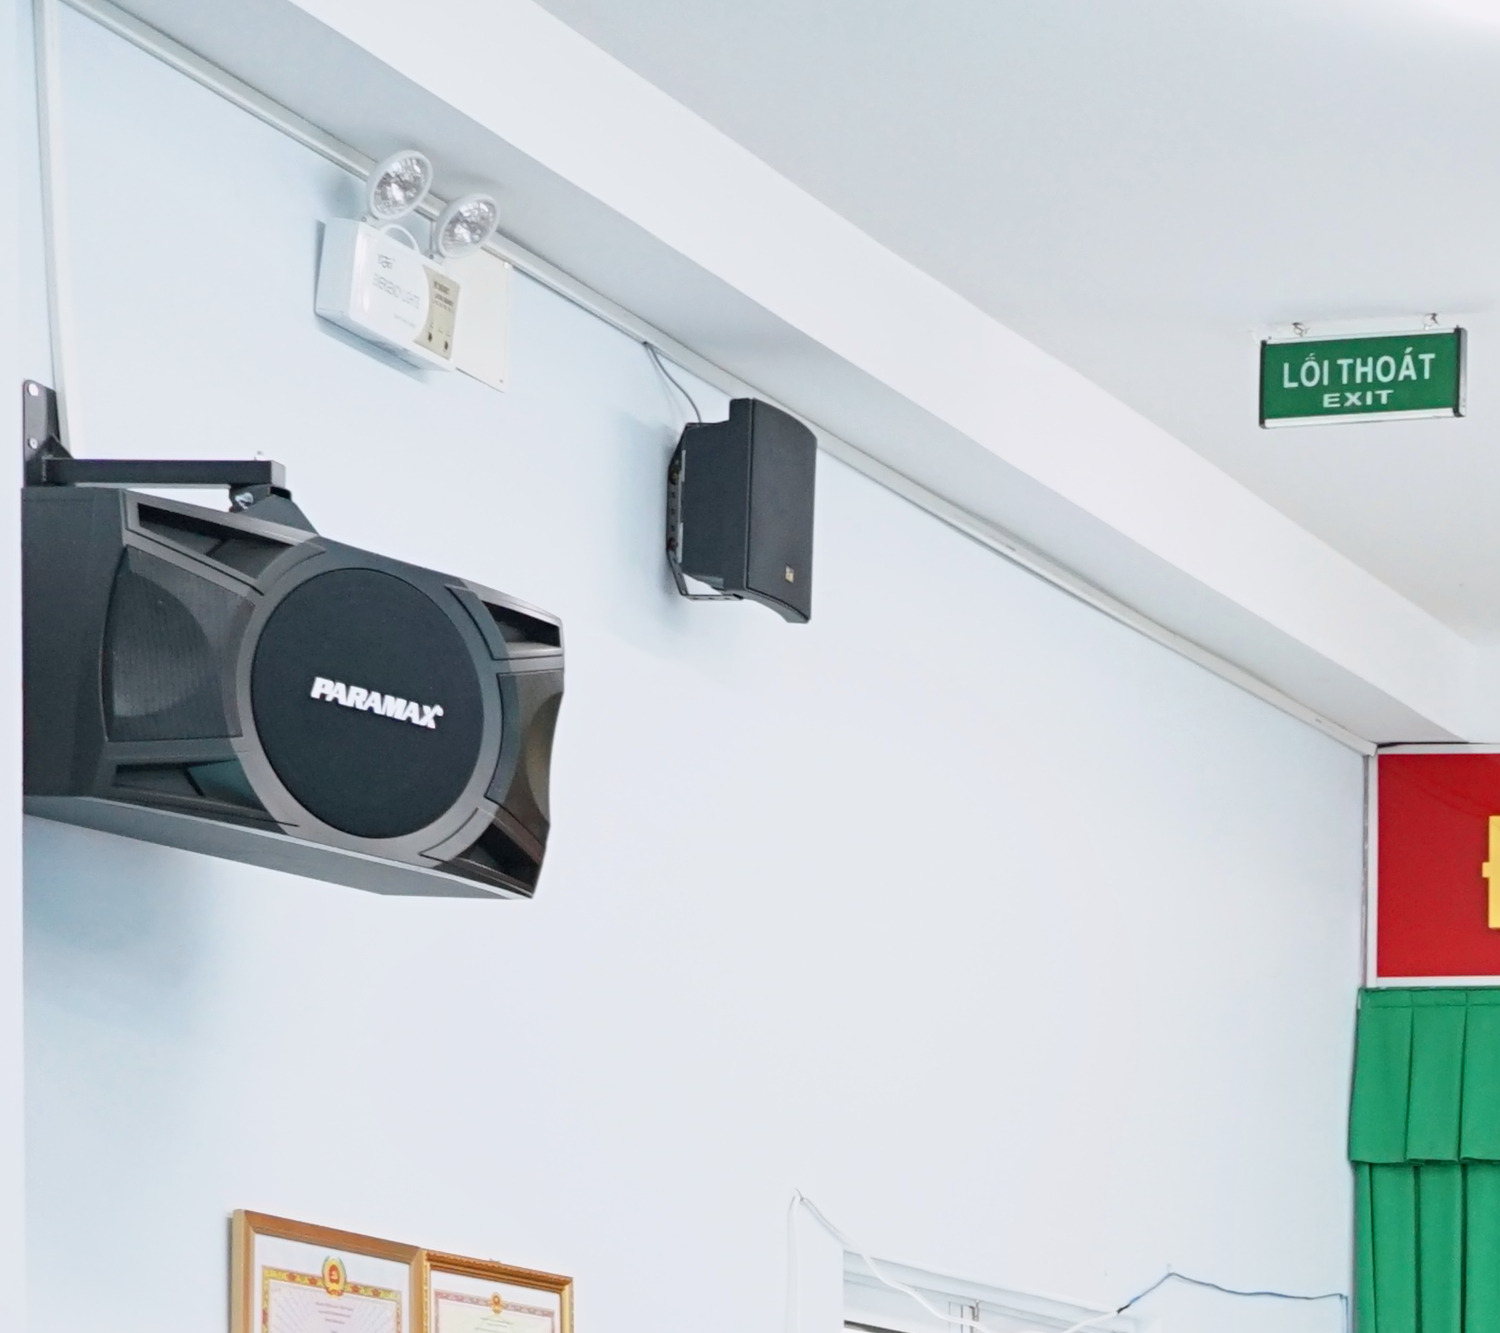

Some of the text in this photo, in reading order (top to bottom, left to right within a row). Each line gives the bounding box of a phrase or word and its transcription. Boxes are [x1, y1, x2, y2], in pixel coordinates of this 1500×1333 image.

[1283, 347, 1436, 388] LỐI THOÁT
[1323, 390, 1394, 408] EXIT
[310, 676, 444, 729] PARAMAX
